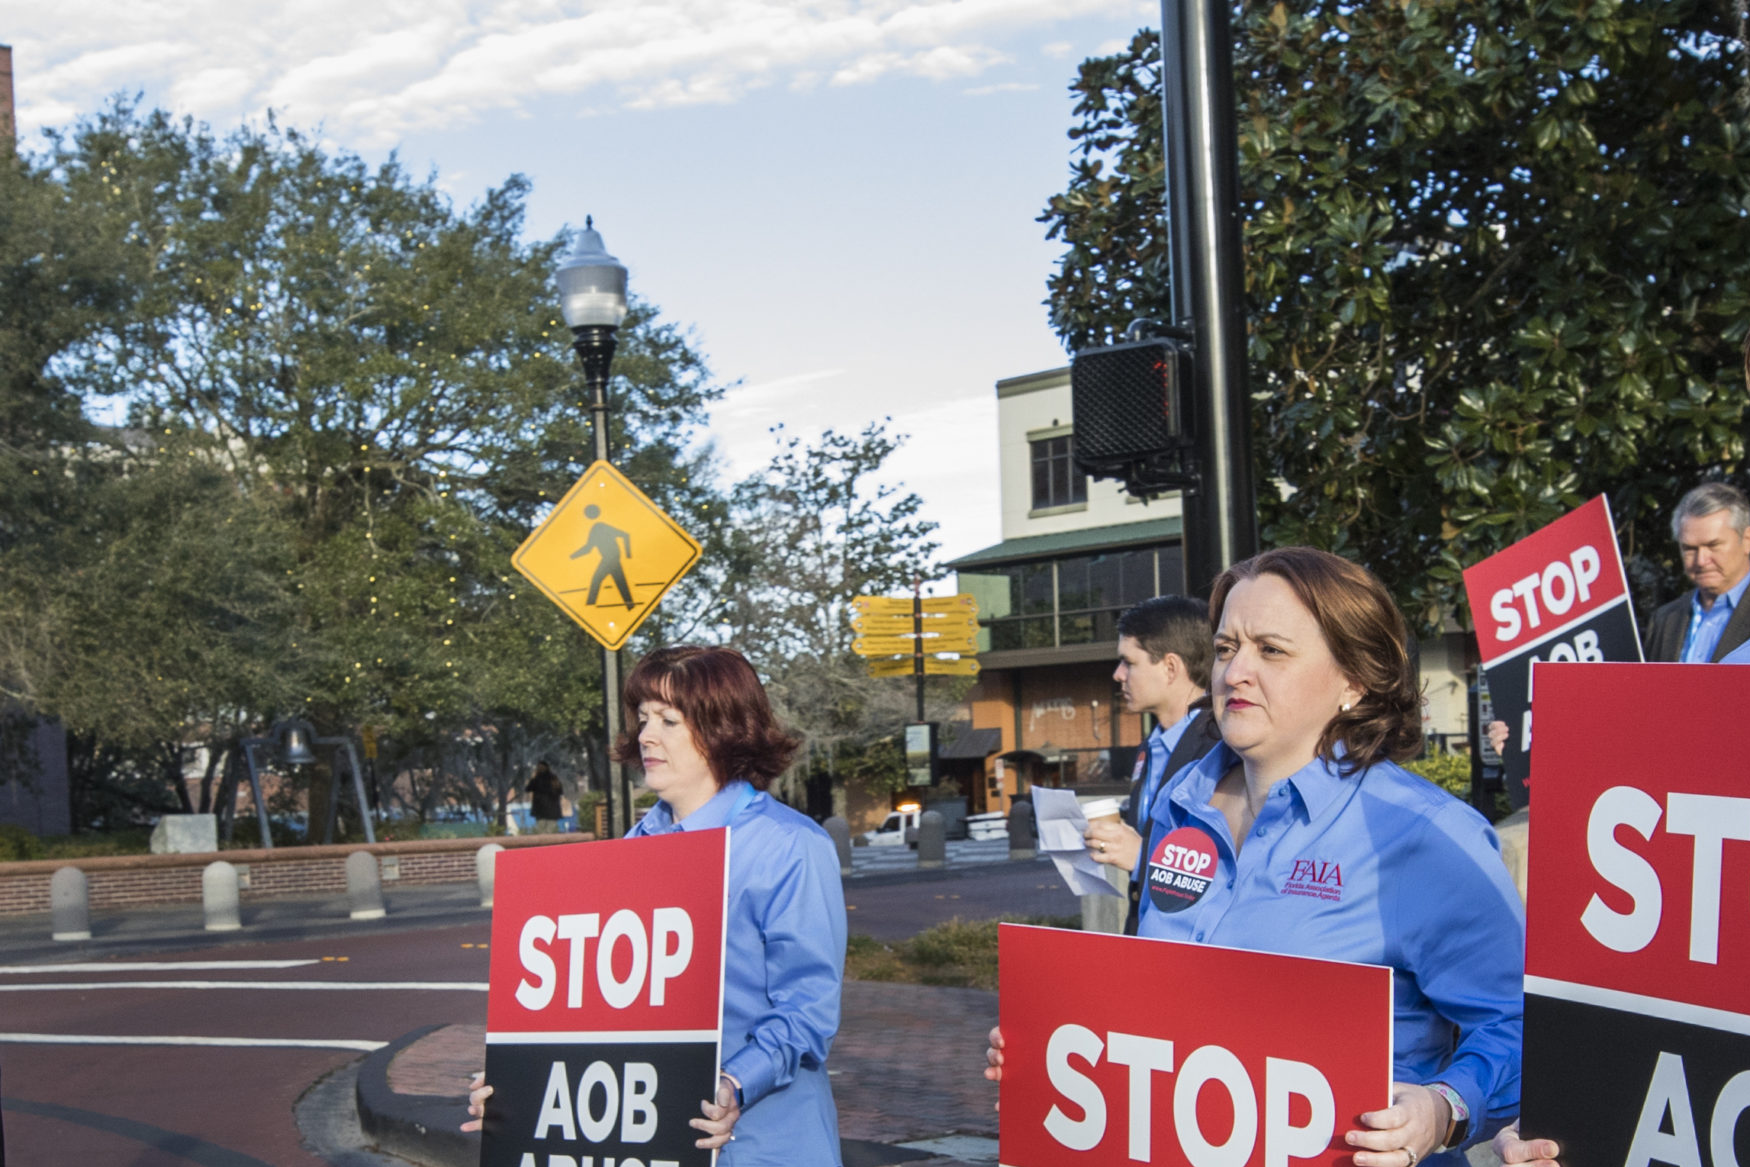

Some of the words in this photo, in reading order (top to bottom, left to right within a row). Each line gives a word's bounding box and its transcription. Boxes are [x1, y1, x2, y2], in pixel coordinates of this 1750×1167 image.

[1490, 545, 1601, 641] STOP
[1150, 868, 1174, 885] AOB
[1172, 874, 1207, 894] ABUSE
[1161, 843, 1211, 874] STOP
[1288, 859, 1344, 887] FAIA
[515, 906, 694, 1011] STOP
[534, 1060, 658, 1143] AOB
